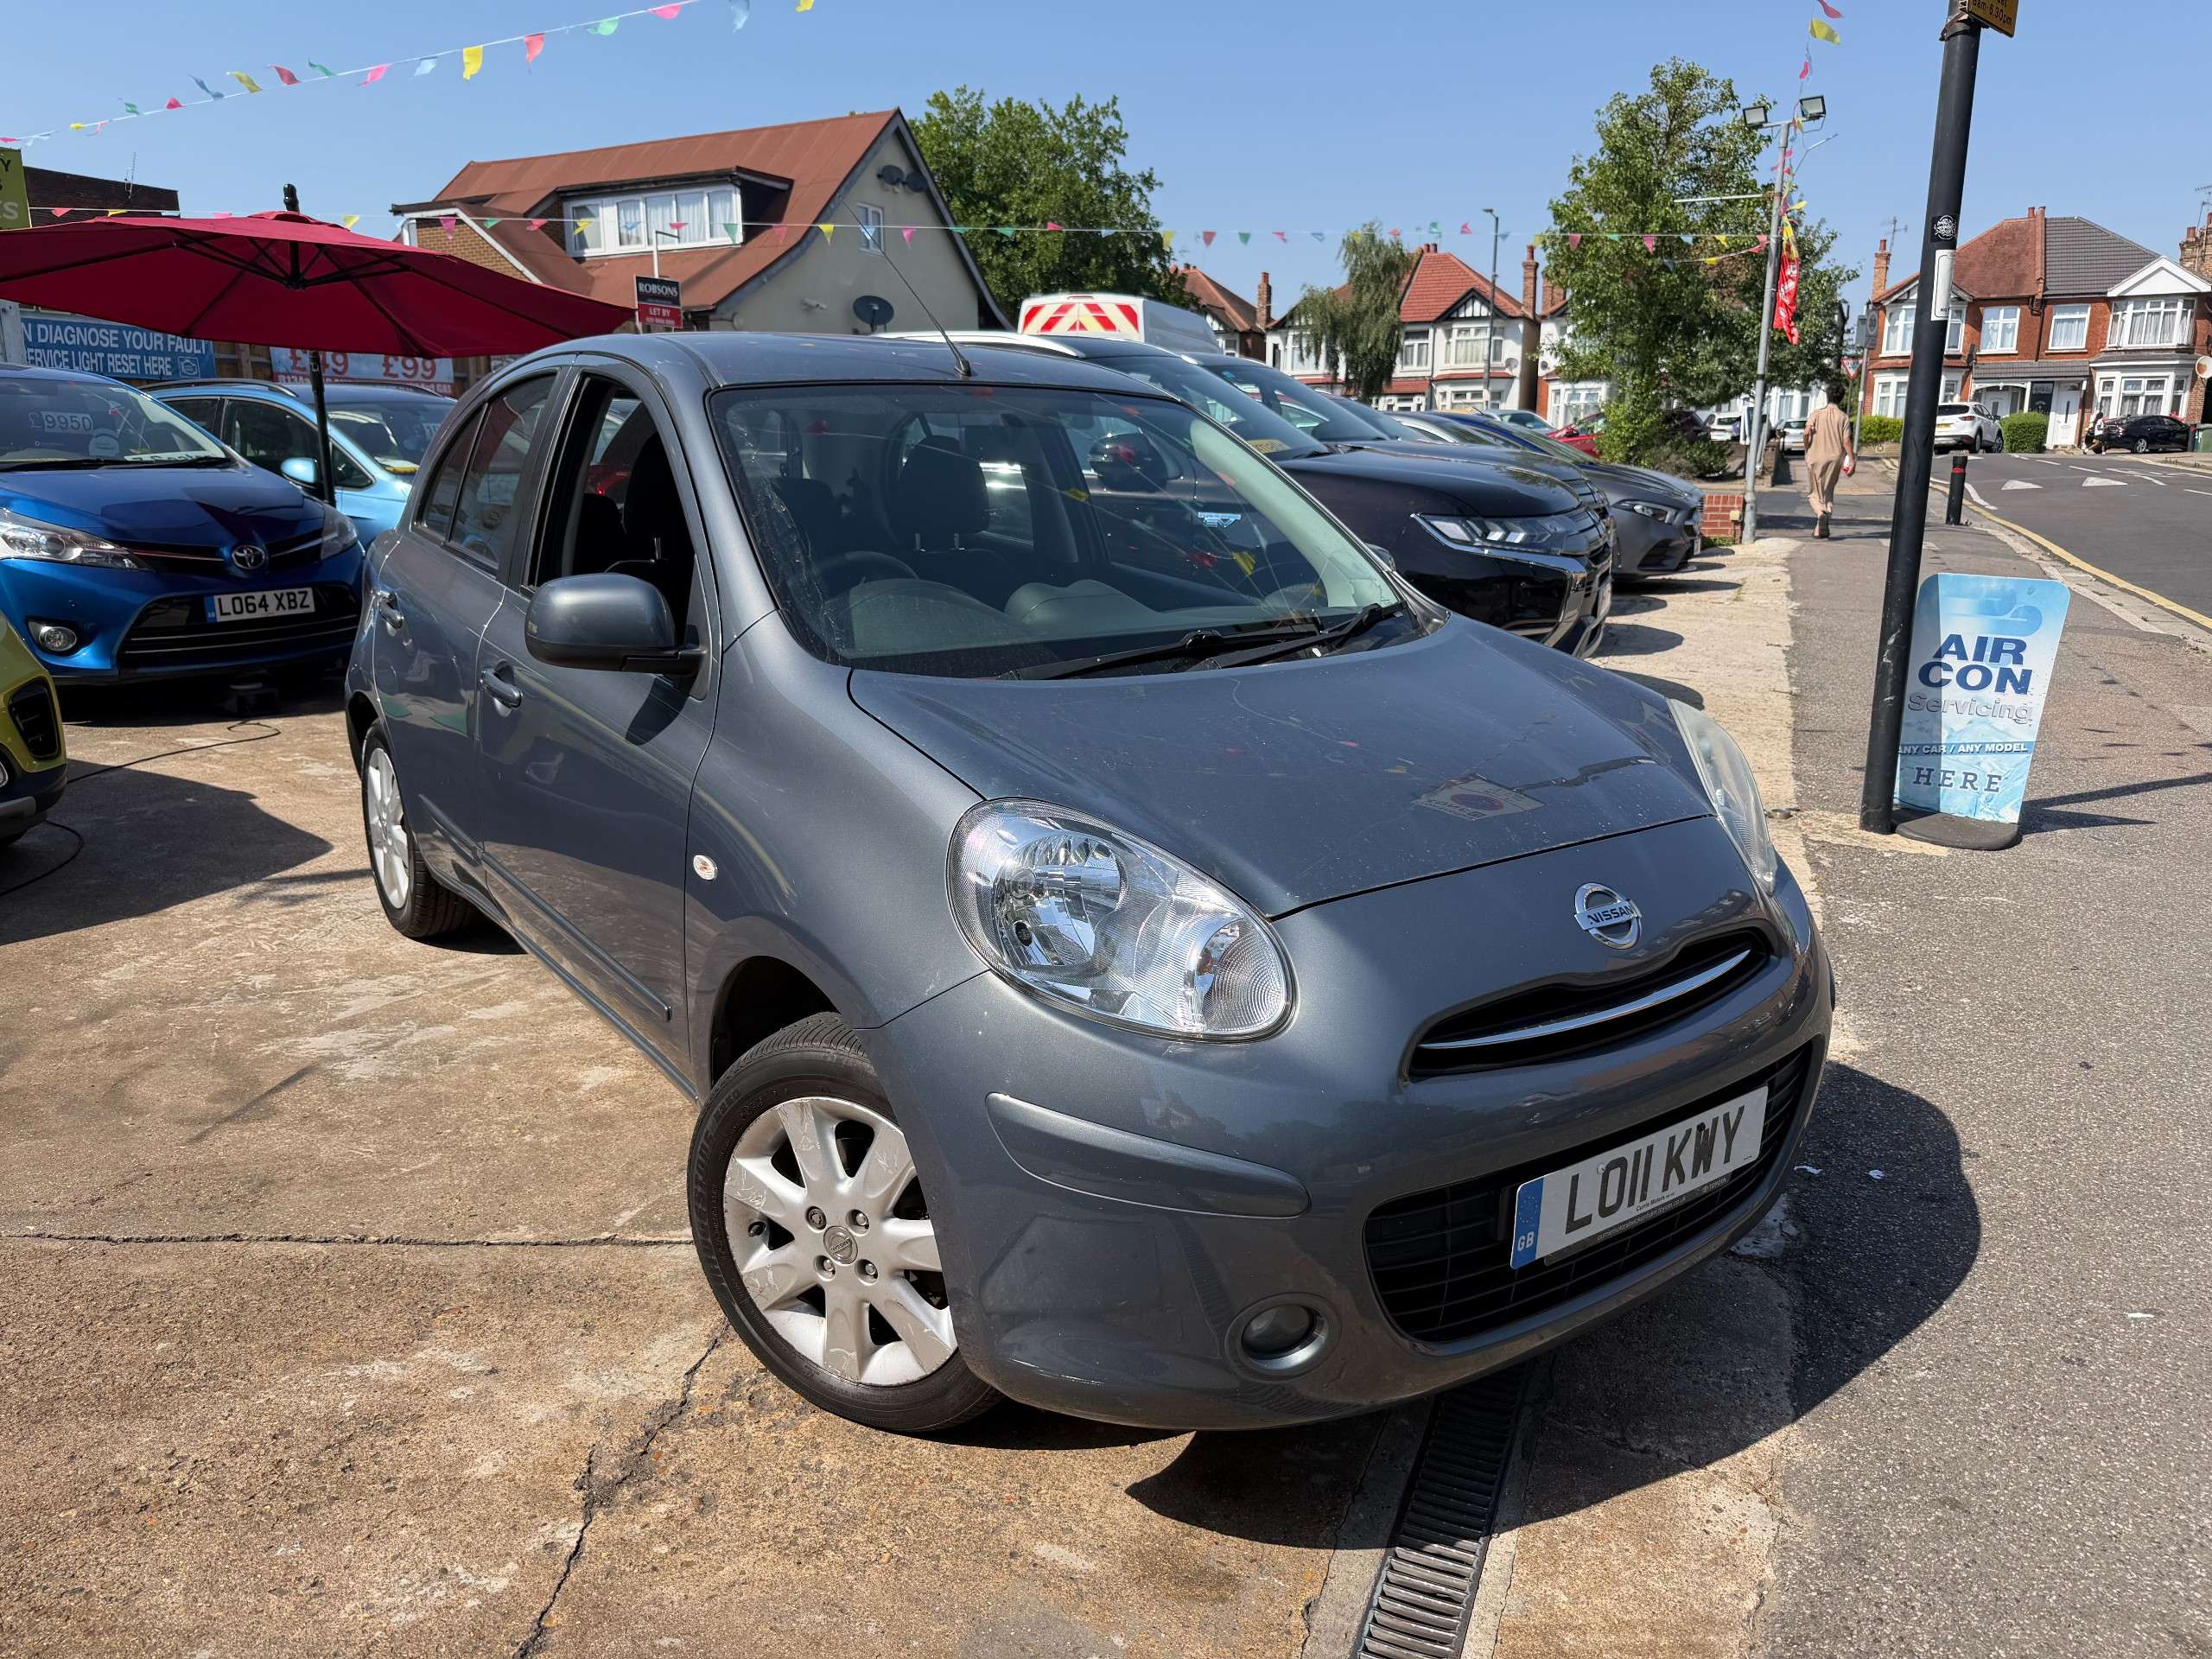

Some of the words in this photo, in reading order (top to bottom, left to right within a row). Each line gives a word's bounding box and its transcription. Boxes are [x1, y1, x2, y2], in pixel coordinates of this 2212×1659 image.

[0, 201, 18, 220] S
[639, 282, 678, 297] ROBSONS
[37, 324, 119, 348] DIAGNOSE
[122, 330, 164, 351] YOUR
[27, 347, 71, 369] ERVICE
[73, 350, 105, 373] LIGHT
[107, 353, 141, 375] RESET
[143, 355, 173, 377] HERE
[383, 353, 436, 381] £99
[29, 411, 93, 432] £9950
[218, 594, 270, 616] LO64
[274, 590, 310, 611] XBZ
[1932, 633, 2027, 665] AIR
[1917, 662, 2032, 695] CON
[1907, 693, 2033, 725] Servicing
[1922, 744, 1947, 754] CAR
[1957, 744, 1983, 754] ANY
[1985, 743, 2028, 753] MODEL
[1913, 766, 2003, 793] HERE
[1588, 904, 1633, 925] NISSAN
[1564, 1145, 1654, 1236] LO11
[1661, 1105, 1745, 1192] KWY
[1516, 1230, 1535, 1251] GB
